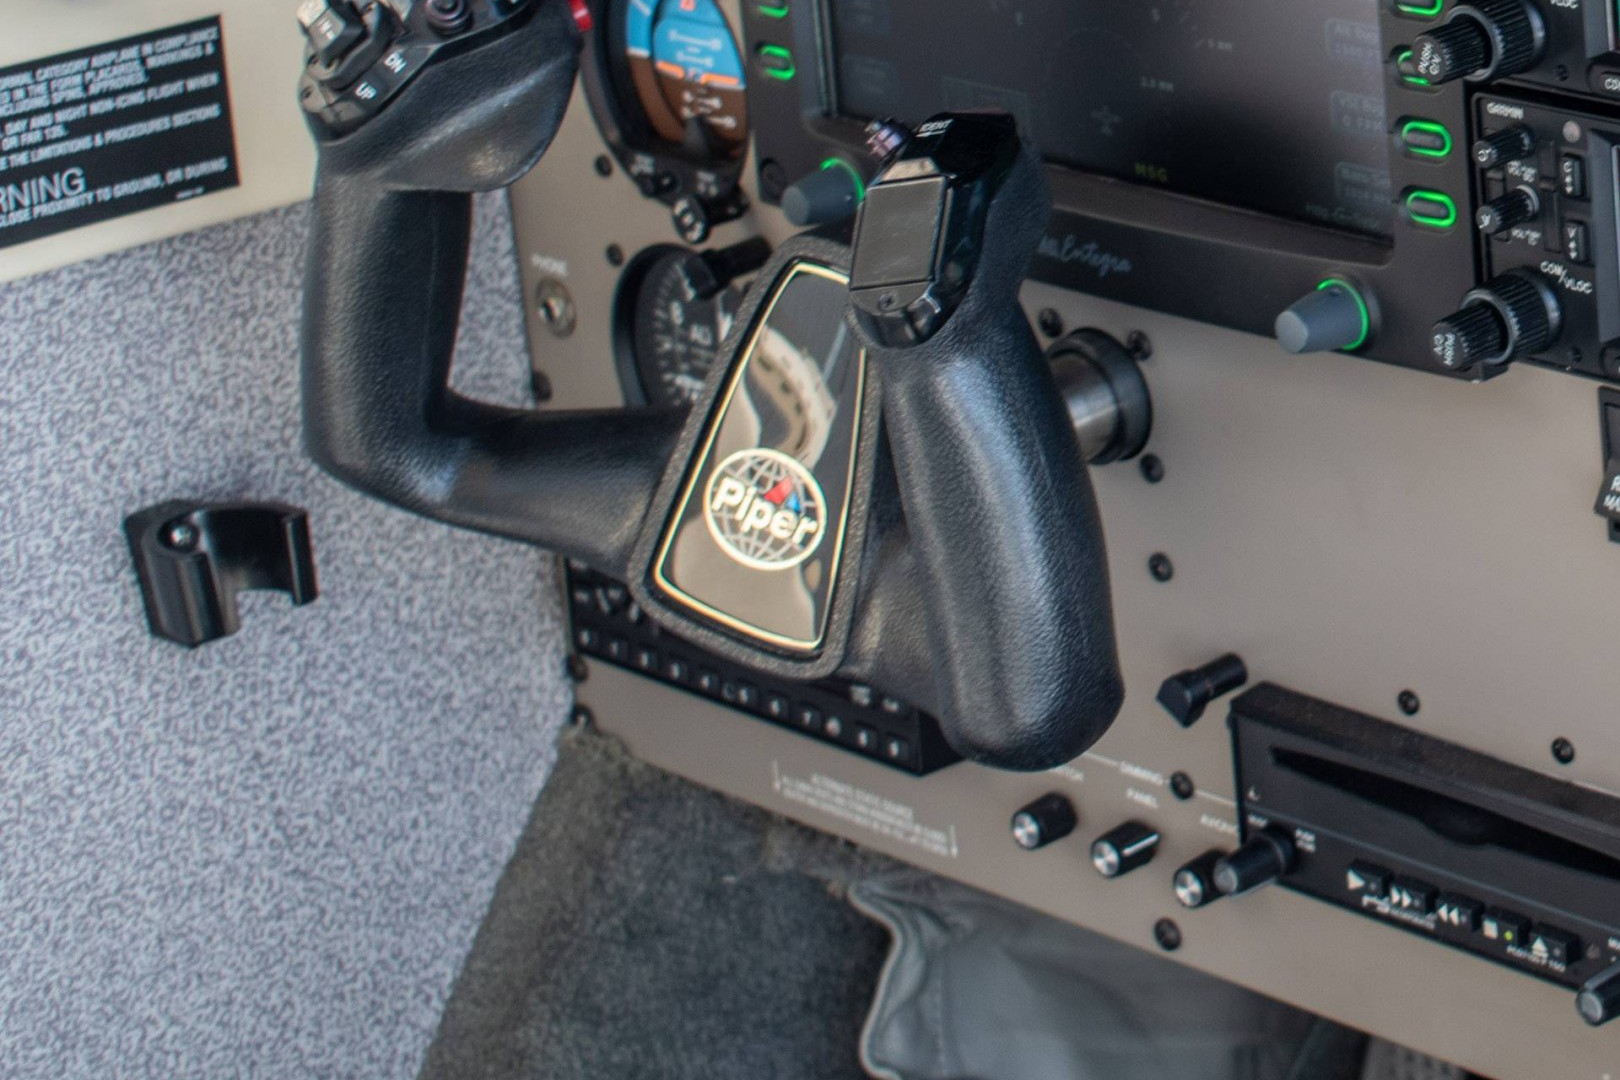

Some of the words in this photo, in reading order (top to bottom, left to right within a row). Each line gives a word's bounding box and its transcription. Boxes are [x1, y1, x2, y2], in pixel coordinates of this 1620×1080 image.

[384, 52, 407, 73] DN
[355, 81, 377, 99] UP
[919, 119, 954, 132] IDENT
[711, 476, 818, 544] Piper
